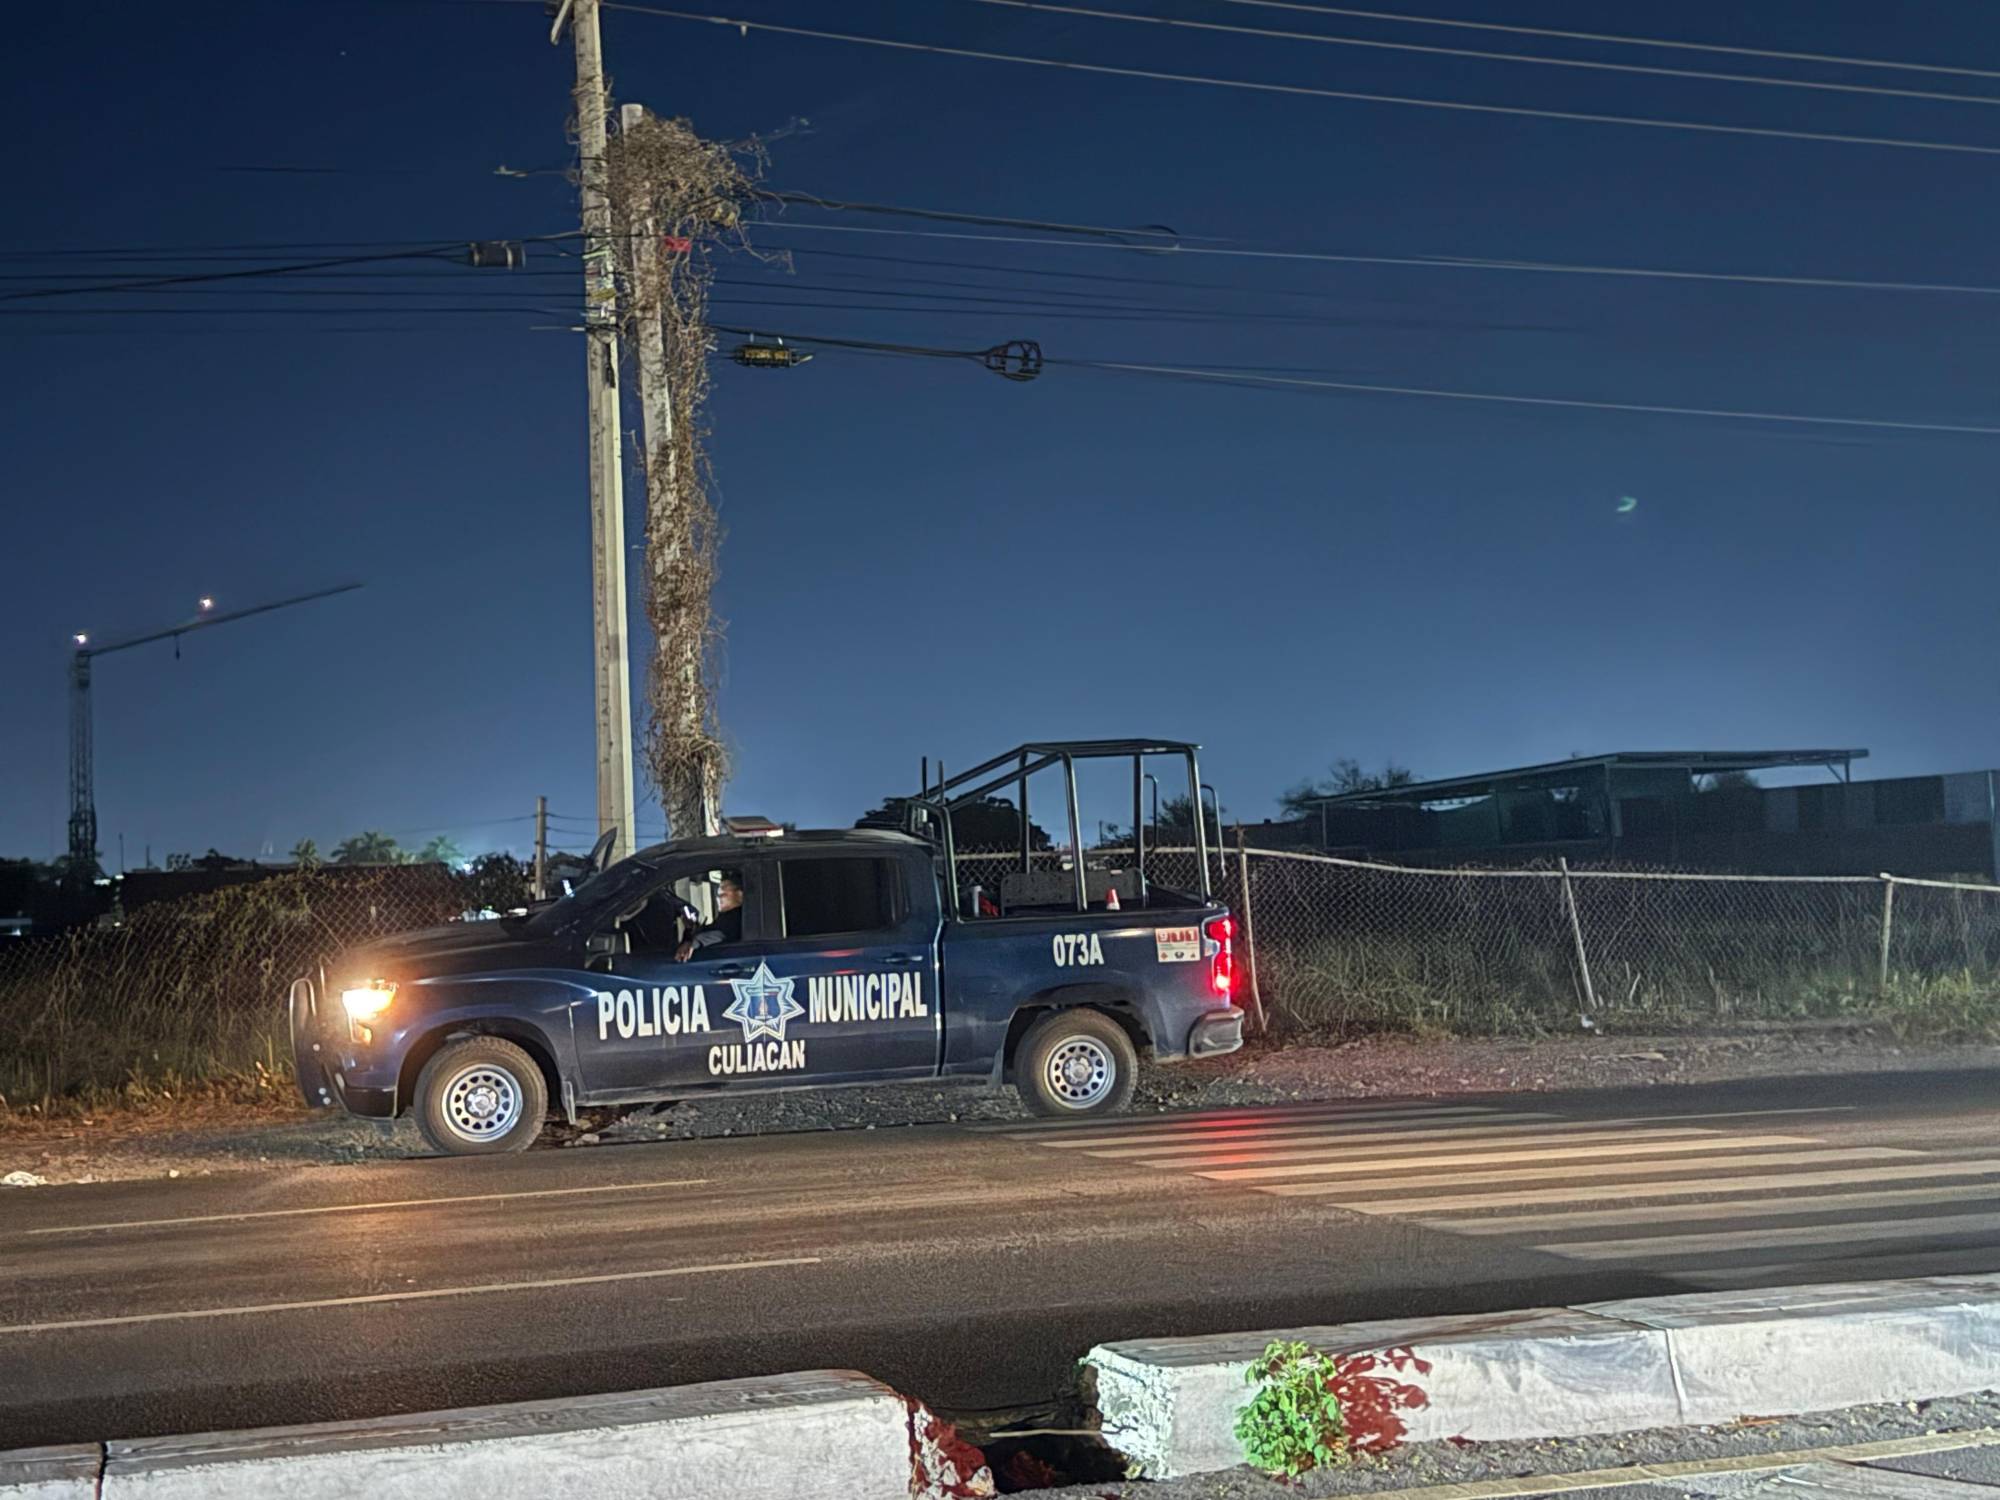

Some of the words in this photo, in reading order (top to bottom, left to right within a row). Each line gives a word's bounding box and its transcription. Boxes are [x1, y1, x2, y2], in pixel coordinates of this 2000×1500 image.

[1053, 933, 1104, 967] 073A
[599, 985, 711, 1040] POLICIA
[808, 972, 928, 1023] MUNICIPAL
[708, 1040, 806, 1075] CULIACAN
